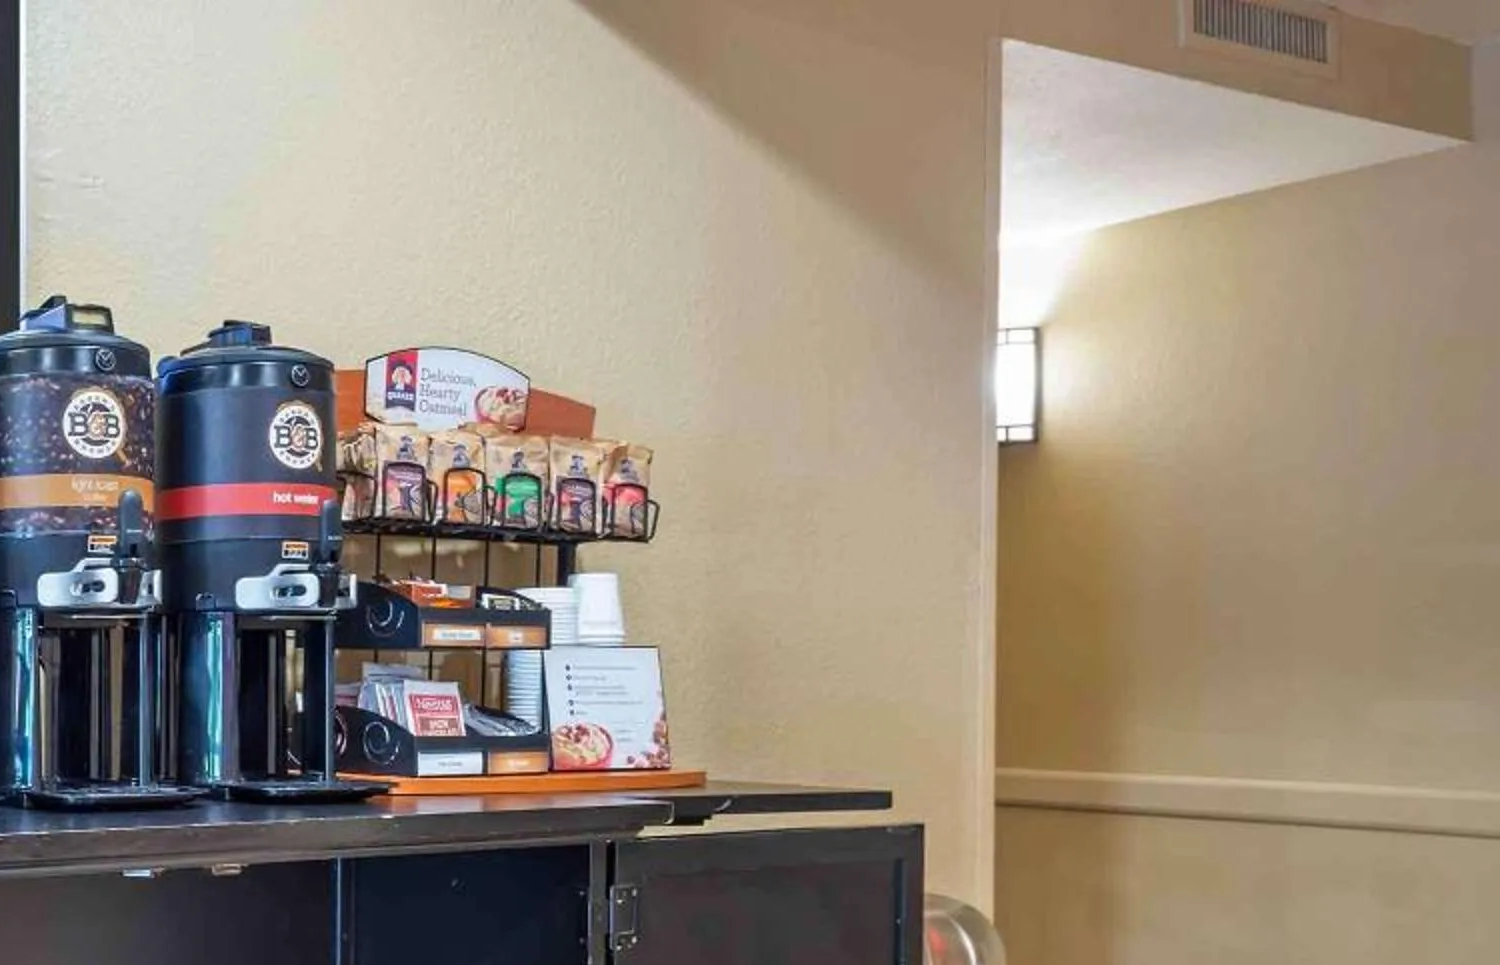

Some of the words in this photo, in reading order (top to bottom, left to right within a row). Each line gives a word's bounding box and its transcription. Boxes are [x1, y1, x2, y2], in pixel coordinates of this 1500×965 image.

[420, 367, 477, 387] Delicious,
[419, 382, 461, 401] Hearty
[418, 399, 468, 417] Oatmeal
[272, 489, 292, 504] hot
